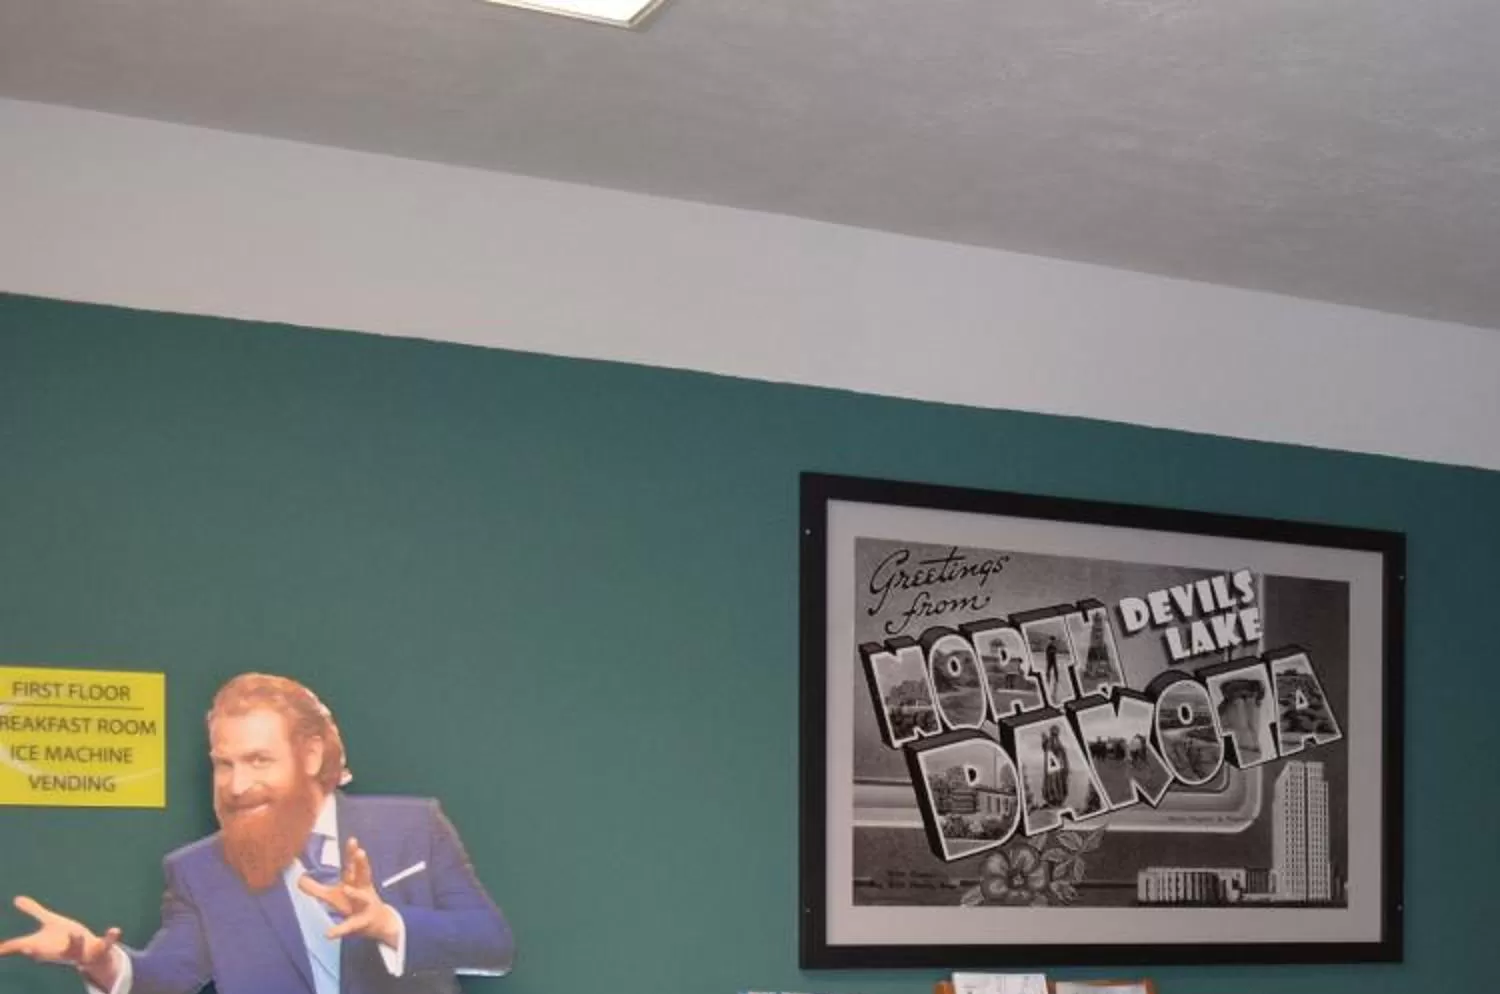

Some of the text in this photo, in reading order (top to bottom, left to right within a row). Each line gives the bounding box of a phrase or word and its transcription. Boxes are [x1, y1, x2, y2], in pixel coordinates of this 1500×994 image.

[867, 546, 1011, 616] Greetings
[1116, 568, 1257, 634] DEVILS
[884, 590, 992, 634] from
[1163, 607, 1264, 663] LAKE
[11, 681, 131, 701] FIRST FLOOR
[860, 600, 1127, 748] NORTH
[0, 715, 157, 736] REAKFAST ROOM
[10, 745, 133, 764] ICE MACHINE
[904, 644, 1343, 862] DAKOTA
[28, 775, 117, 793] VENDING
